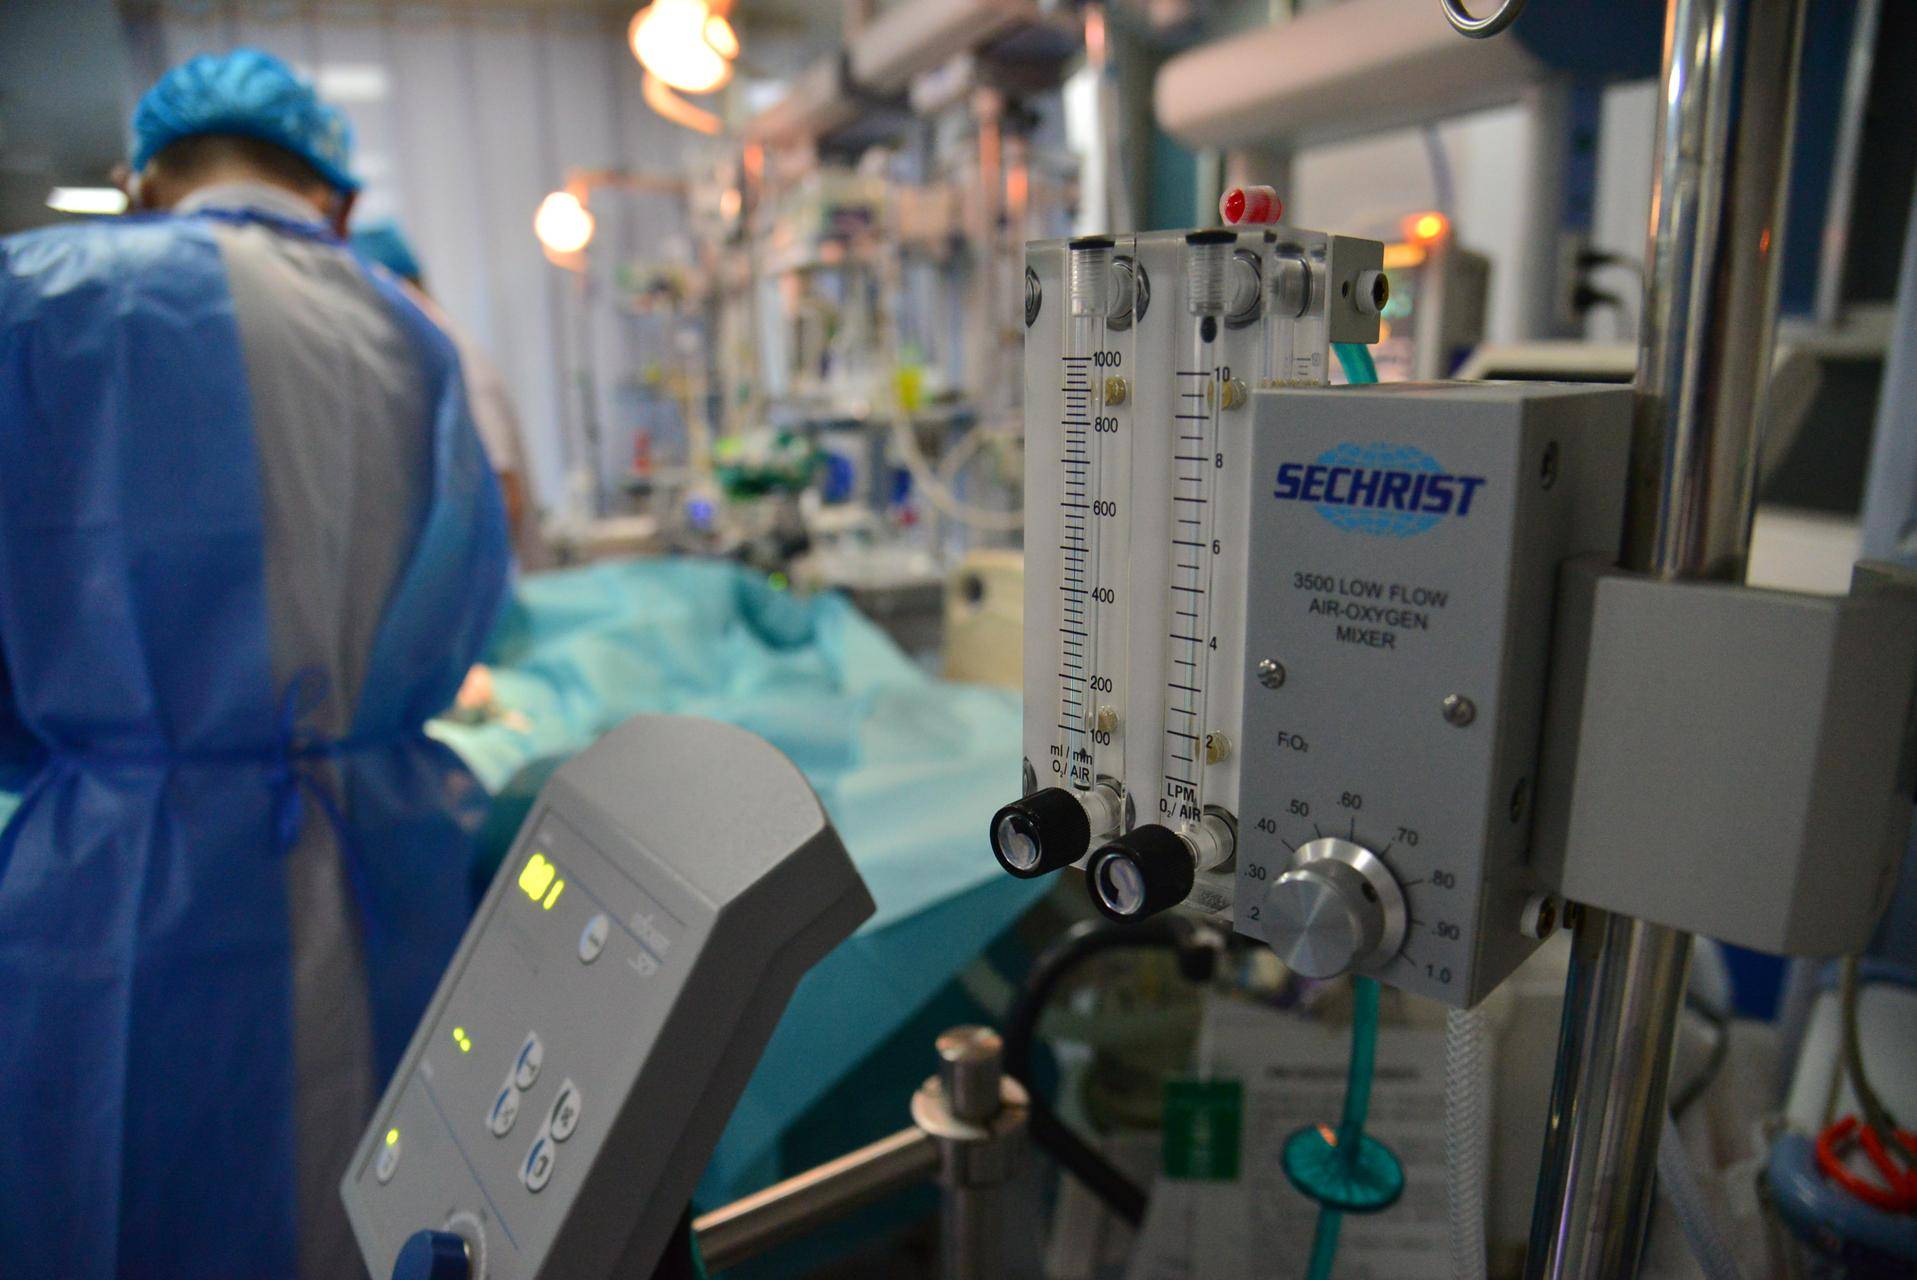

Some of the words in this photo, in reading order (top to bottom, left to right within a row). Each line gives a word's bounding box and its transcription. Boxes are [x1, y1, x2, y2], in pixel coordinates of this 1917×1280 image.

[1093, 350, 1121, 368] 1000
[1214, 366, 1230, 383] 10
[1094, 417, 1119, 434] 800
[1215, 453, 1223, 469] 8
[1273, 462, 1486, 517] SECHRIST
[1093, 500, 1117, 517] 600
[1212, 539, 1221, 554] 6
[1091, 587, 1115, 604] 400
[1293, 572, 1335, 593] 3500
[1340, 579, 1383, 599] LOW
[1389, 585, 1449, 608] FLOW
[1308, 598, 1429, 630] AIR-OXYGEN
[1209, 636, 1217, 651] 4
[1336, 625, 1396, 649] MIXER
[1090, 675, 1113, 693] 200
[1090, 728, 1111, 746] 100
[1205, 734, 1214, 749] 2
[1070, 765, 1090, 782] AIR
[1167, 782, 1195, 803] LPM
[1180, 804, 1201, 822] AIR
